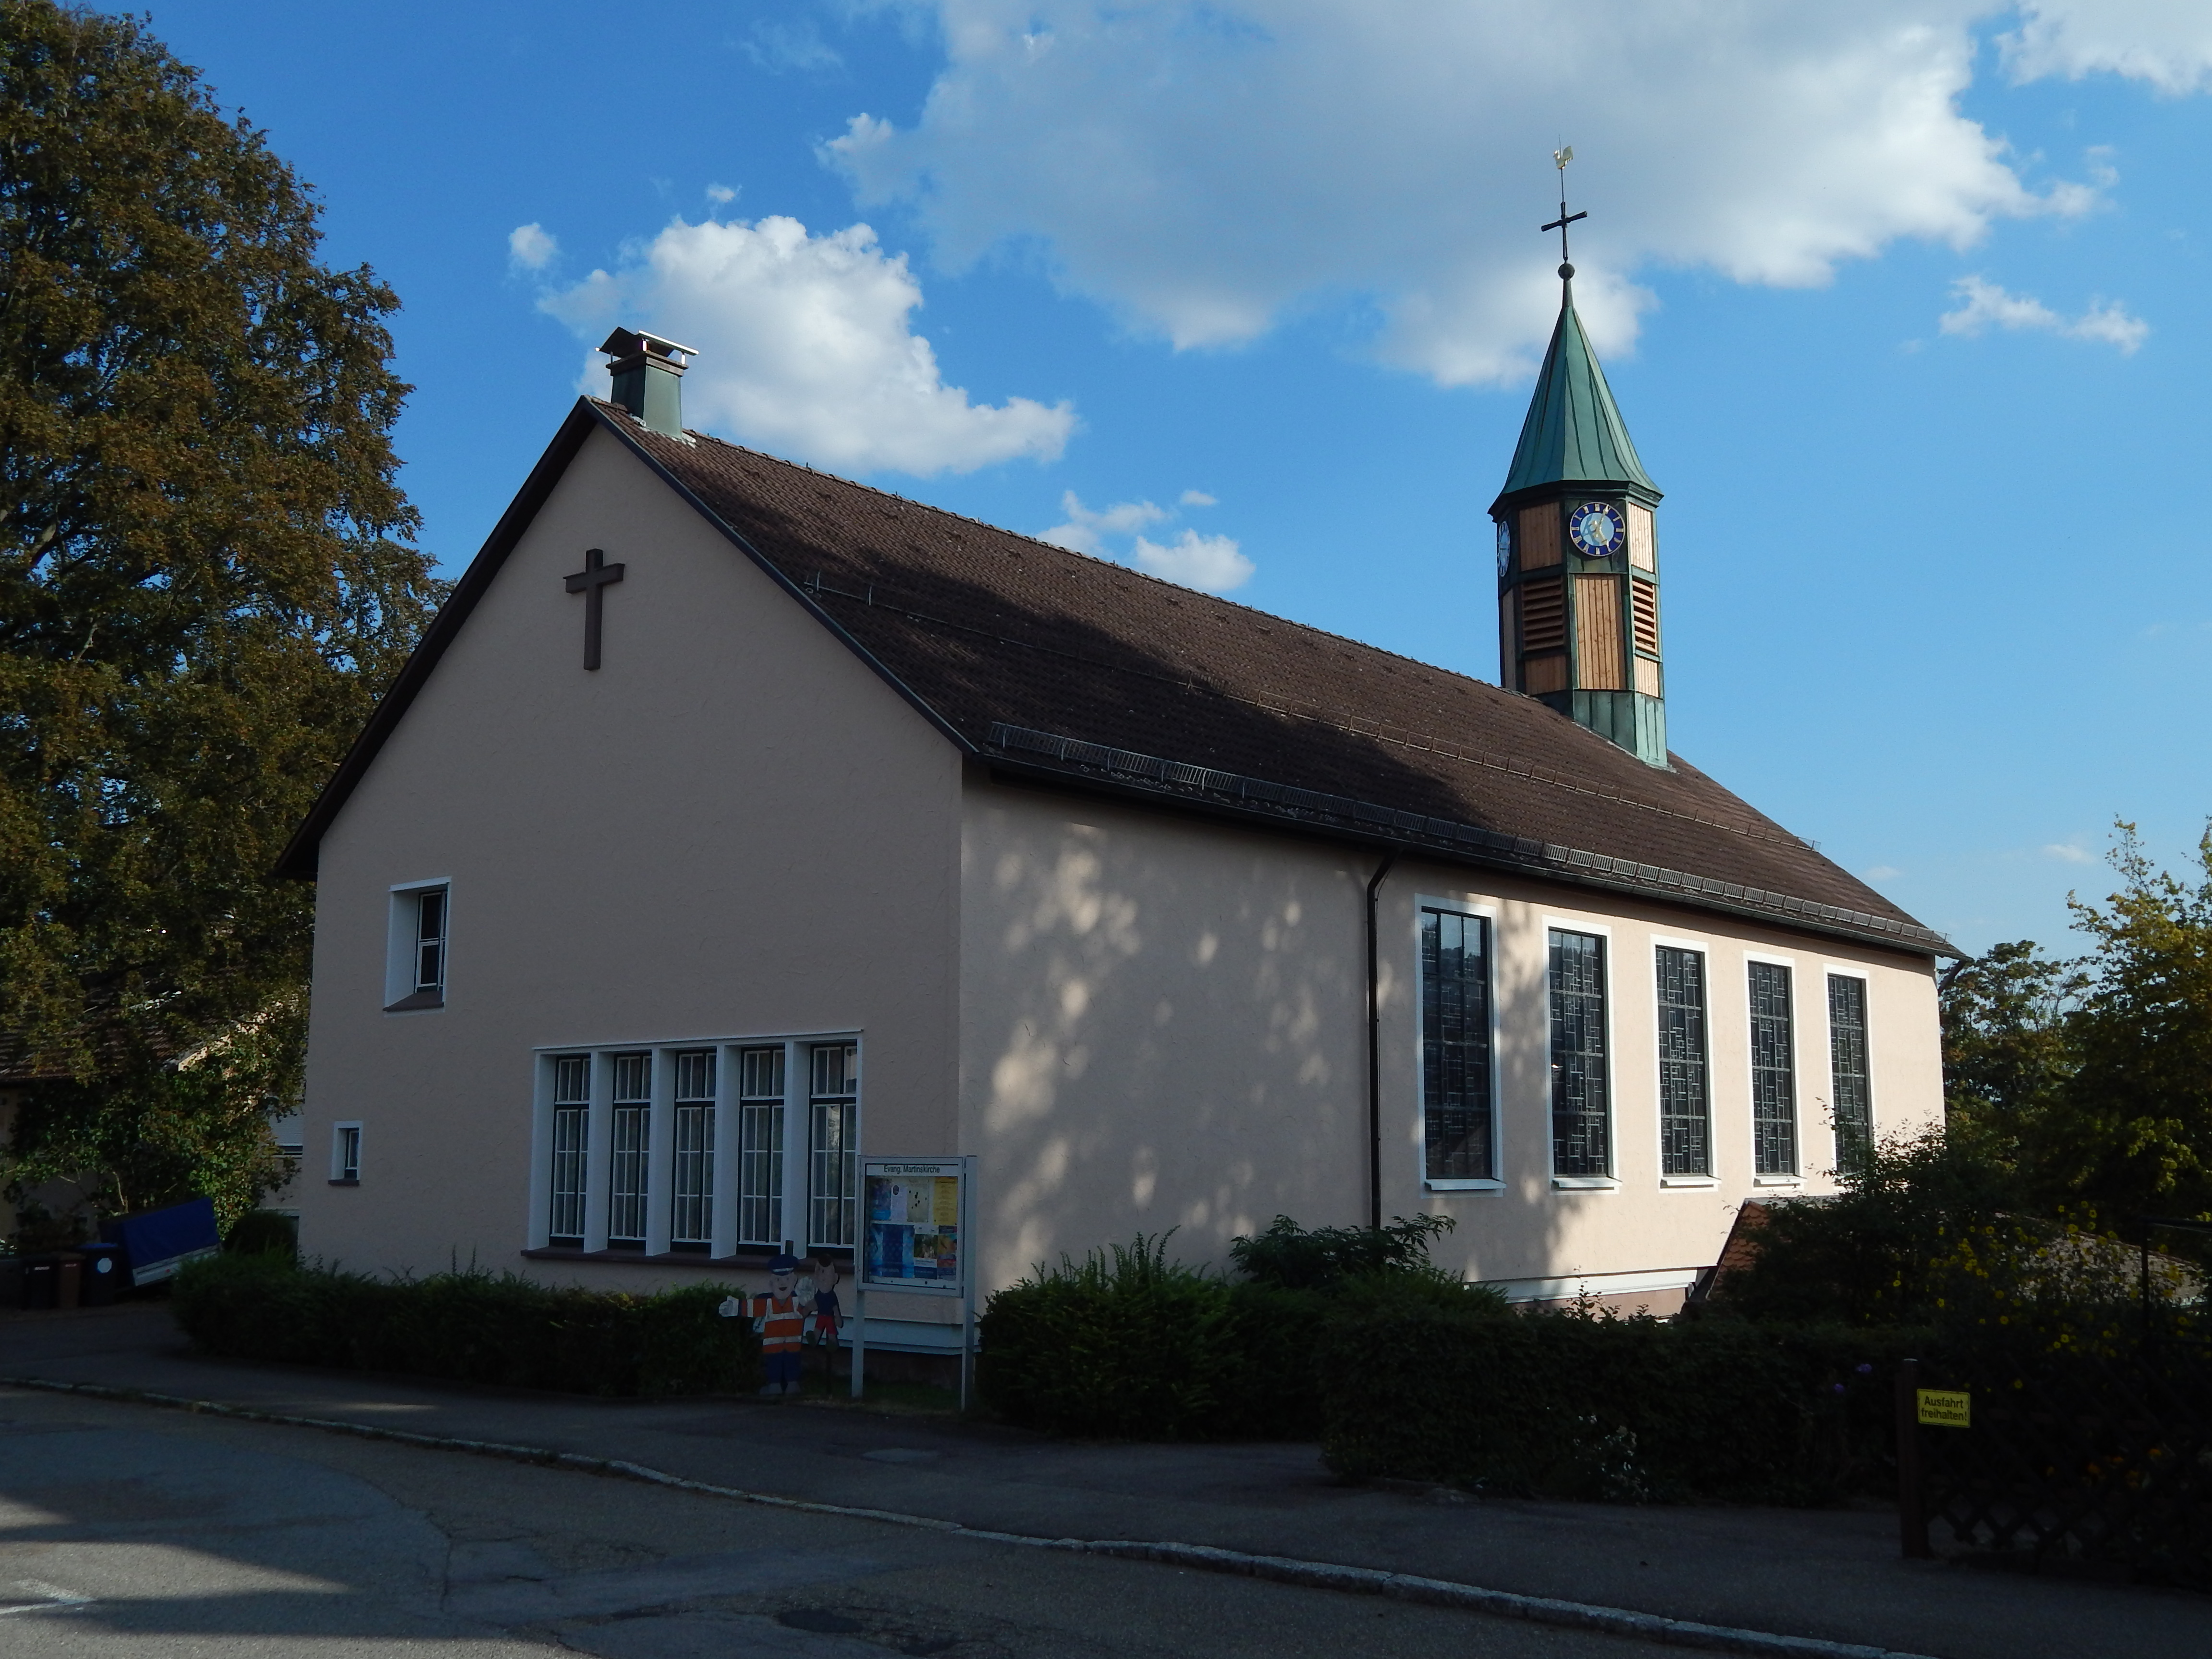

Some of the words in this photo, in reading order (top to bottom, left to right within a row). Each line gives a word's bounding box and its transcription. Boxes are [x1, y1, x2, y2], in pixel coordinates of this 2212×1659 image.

[884, 1165, 901, 1174] Evang.
[903, 1165, 940, 1173] Martinskirche
[1924, 1395, 1963, 1408] Ausfahrt
[1921, 1407, 1967, 1421] freihalten!
